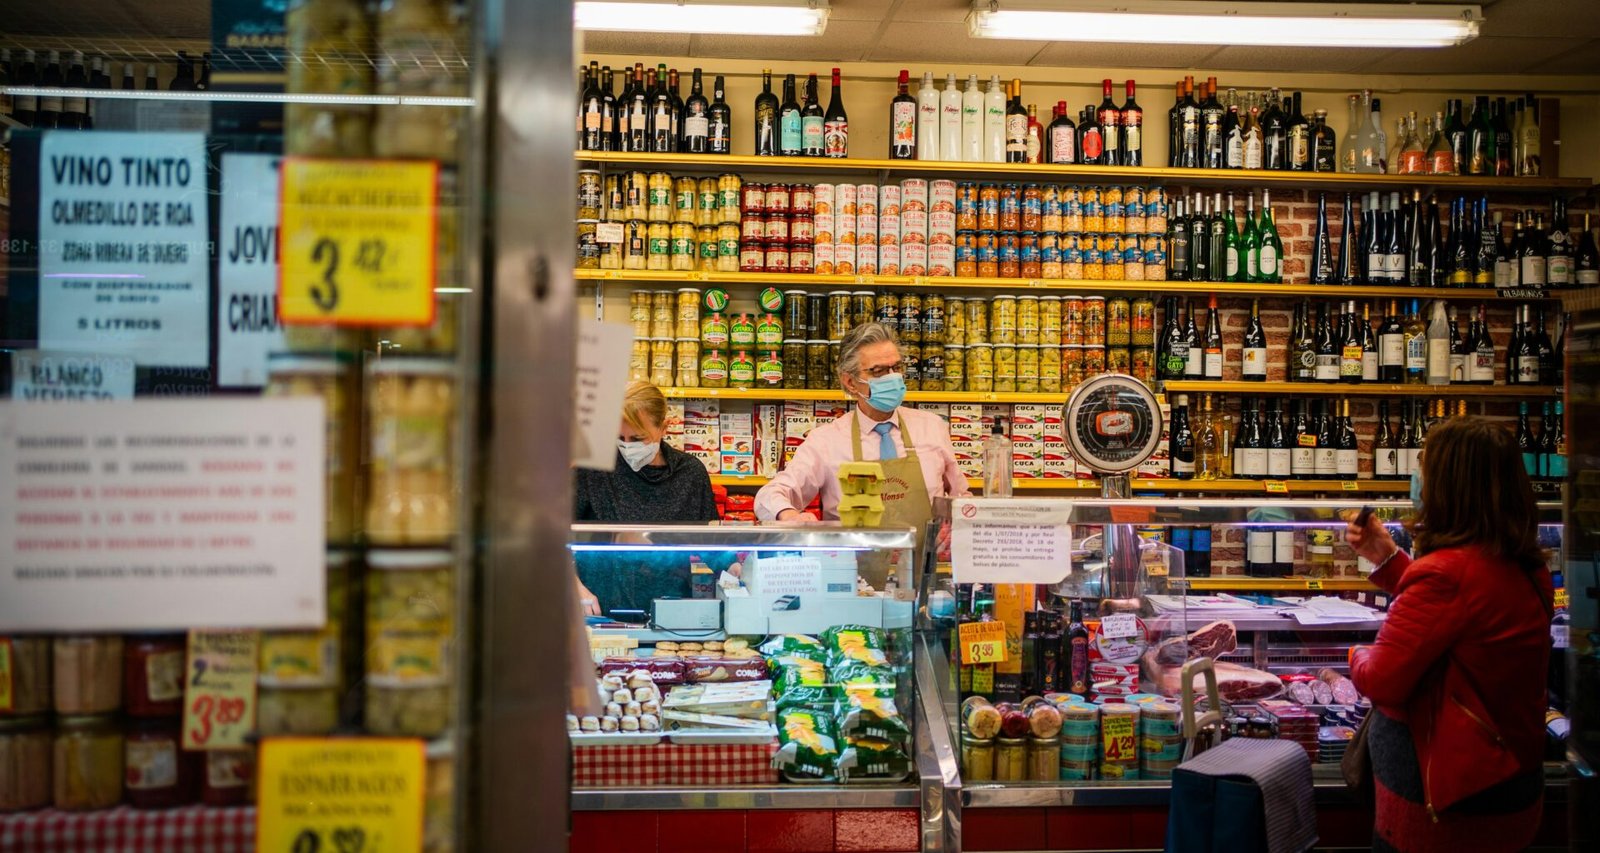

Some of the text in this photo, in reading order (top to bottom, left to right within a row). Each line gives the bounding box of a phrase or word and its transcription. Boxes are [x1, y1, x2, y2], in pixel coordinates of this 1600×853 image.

[52, 155, 191, 188] VINO TINTO
[52, 201, 194, 228] OLMEDILLO DE ROA
[309, 237, 341, 312] 3
[77, 318, 162, 331] 5 LITROS
[229, 294, 285, 332] CRIAN
[31, 363, 104, 387] BLANCO
[190, 694, 213, 745] 3
